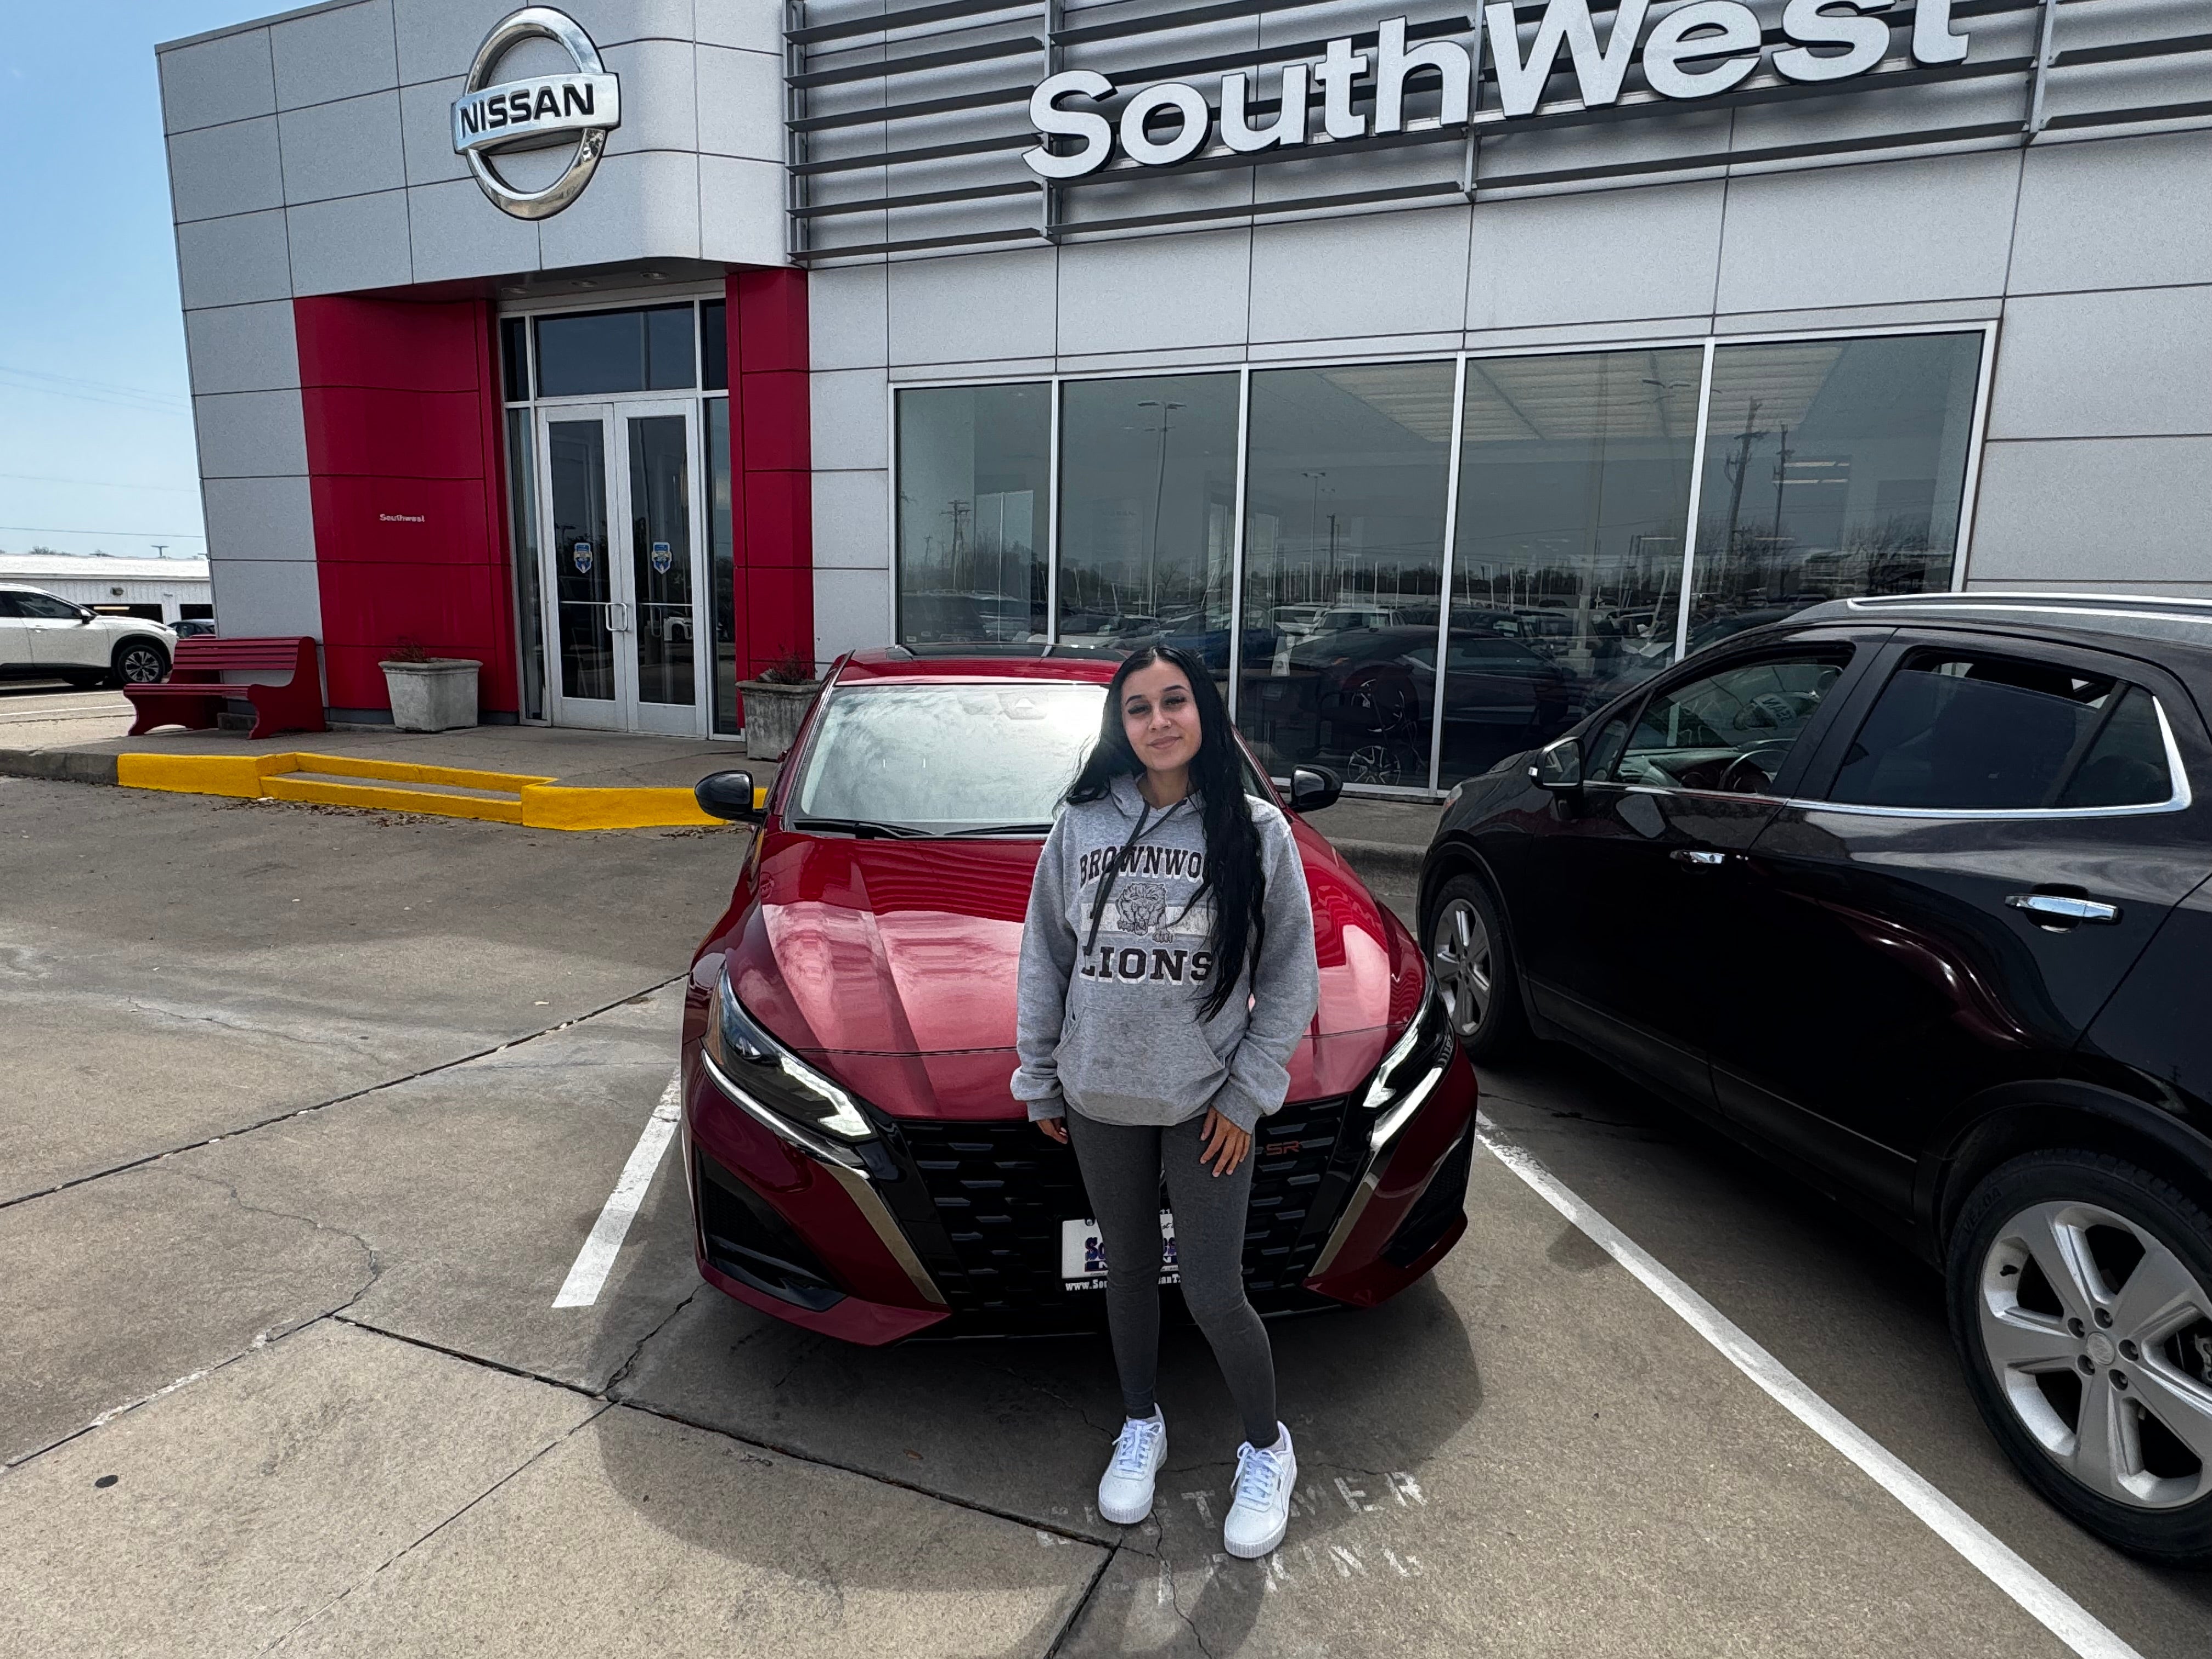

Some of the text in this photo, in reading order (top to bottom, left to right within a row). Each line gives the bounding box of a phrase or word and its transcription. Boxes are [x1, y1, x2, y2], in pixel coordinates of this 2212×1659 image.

[1021, 0, 1971, 179] SouthWest
[460, 83, 595, 138] NISSAN
[379, 514, 425, 522] Southwest
[1080, 945, 1213, 985] LIONS
[1266, 1141, 1300, 1156] SR
